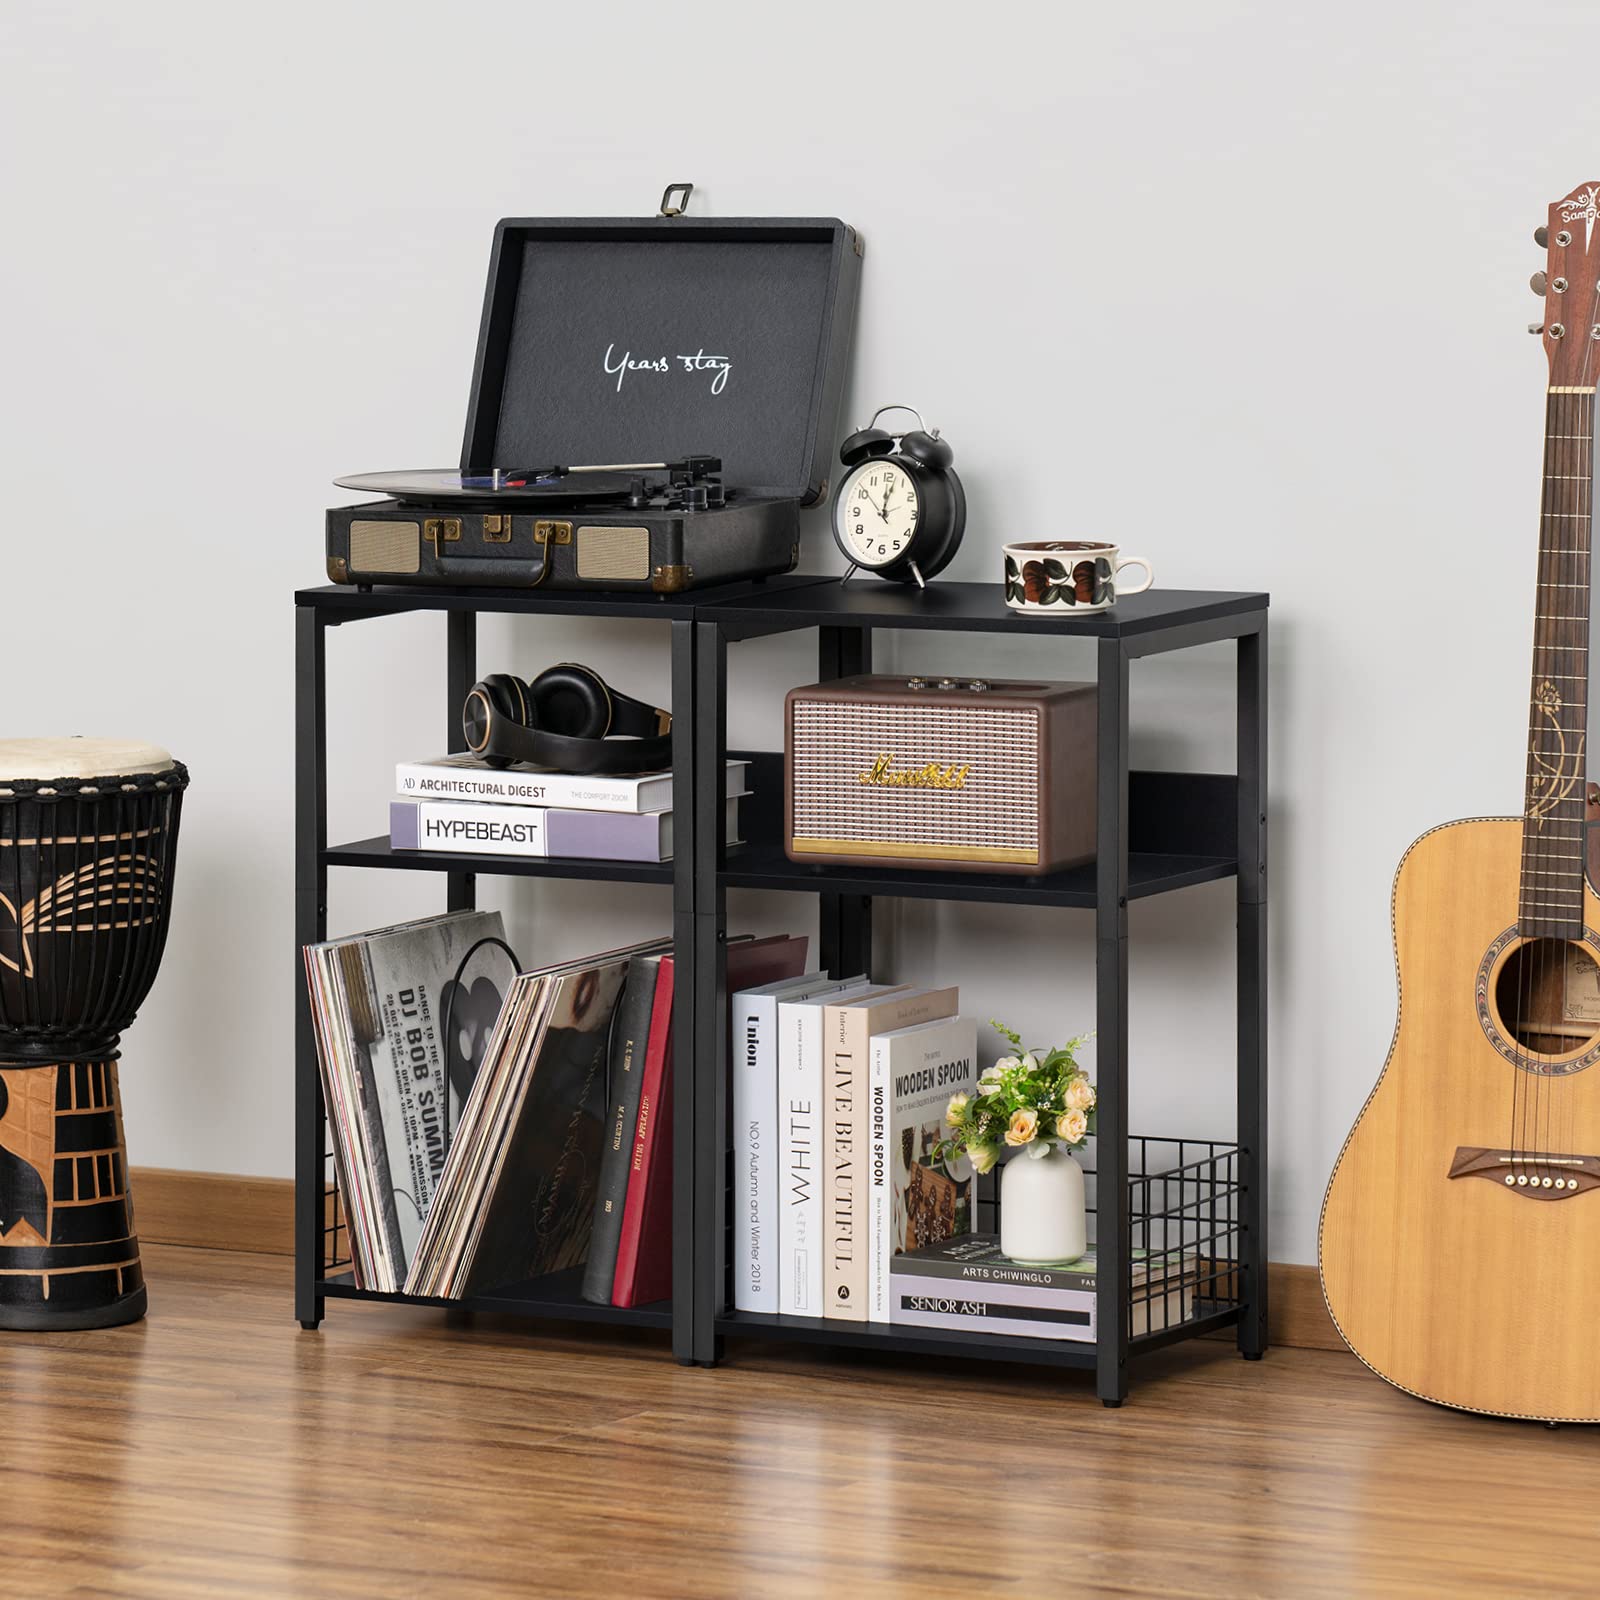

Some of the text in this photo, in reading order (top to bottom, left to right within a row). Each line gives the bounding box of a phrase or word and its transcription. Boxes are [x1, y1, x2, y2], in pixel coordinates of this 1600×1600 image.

[604, 344, 733, 395] Years stay
[870, 476, 878, 487] 11
[883, 472, 894, 482] 12
[858, 489, 869, 500] 10
[906, 492, 915, 502] 2
[852, 507, 861, 517] 9
[910, 510, 918, 521] 3
[855, 525, 864, 535] 8
[903, 528, 911, 538] 4
[866, 538, 874, 549] 7
[878, 545, 886, 555] 6
[892, 541, 901, 551] 5
[403, 777, 546, 799] AD ARCHITECTURAL DIGEST
[426, 819, 538, 843] HYPEBEAST
[418, 985, 431, 1022] DANCE
[426, 1026, 435, 1040] TO
[839, 1011, 848, 1045] Interior
[747, 1016, 760, 1067] Union
[430, 1044, 440, 1065] THE
[399, 989, 446, 1188] DJ BOB SUMM
[401, 1069, 411, 1094] OPEN
[895, 1058, 970, 1098] WOODEN SPOON
[406, 1098, 414, 1109] AT
[409, 1115, 419, 1140] 10PM
[873, 1086, 884, 1187] WOODEN SPOON
[790, 1100, 811, 1206] WHITE
[835, 1053, 853, 1271] LIVE BEAUTIFUL
[416, 1154, 429, 1204] ADMISSON
[750, 1121, 761, 1292] NO.9 Autumn and Winter 2018
[963, 1267, 1052, 1284] ARTS CHIWINGLO
[910, 1296, 987, 1316] SENIOR ASH
